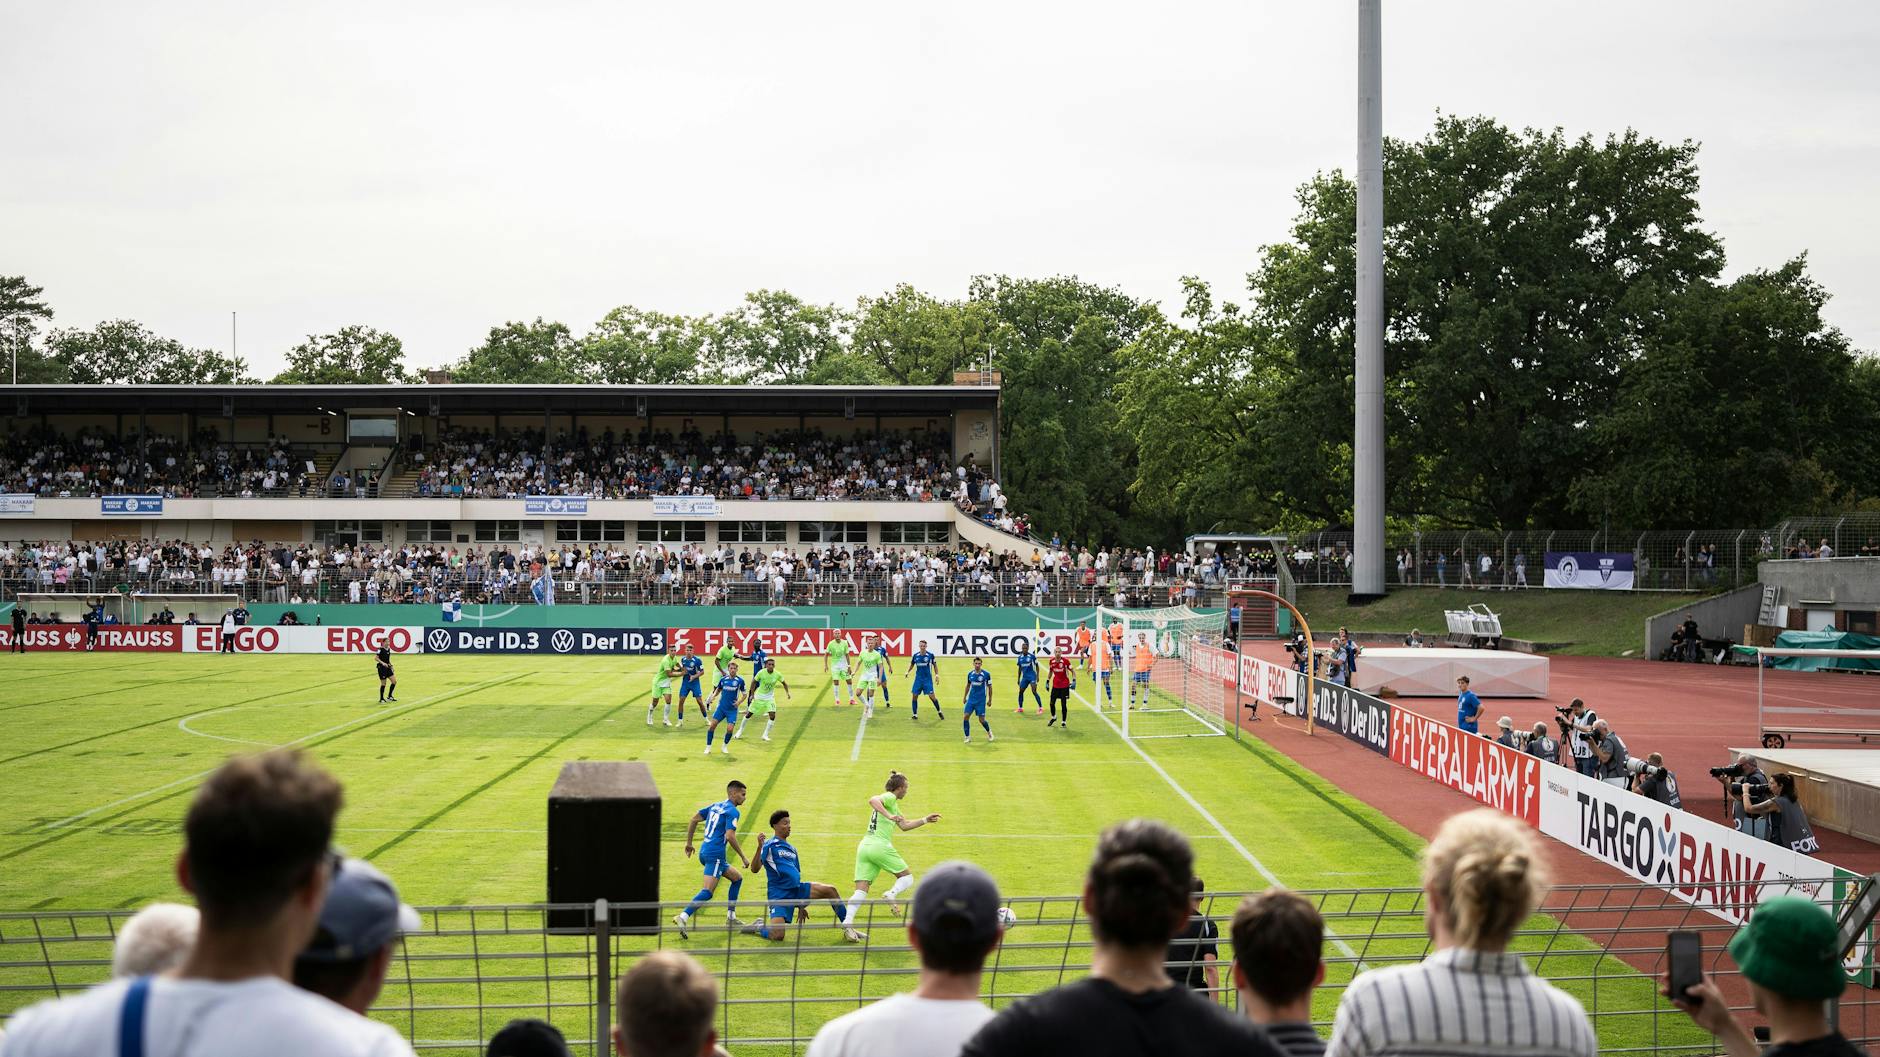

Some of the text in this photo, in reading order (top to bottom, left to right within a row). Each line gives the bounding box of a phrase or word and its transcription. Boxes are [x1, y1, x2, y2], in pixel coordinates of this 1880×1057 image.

[327, 627, 411, 652] ERGO
[458, 632, 540, 650] Der ID.3
[582, 632, 664, 651] Der ID.3
[1243, 658, 1260, 697] ERGO
[1320, 687, 1338, 725] ID.3
[1351, 698, 1388, 749] Der ID.3
[1402, 712, 1519, 817] FLYERALARM
